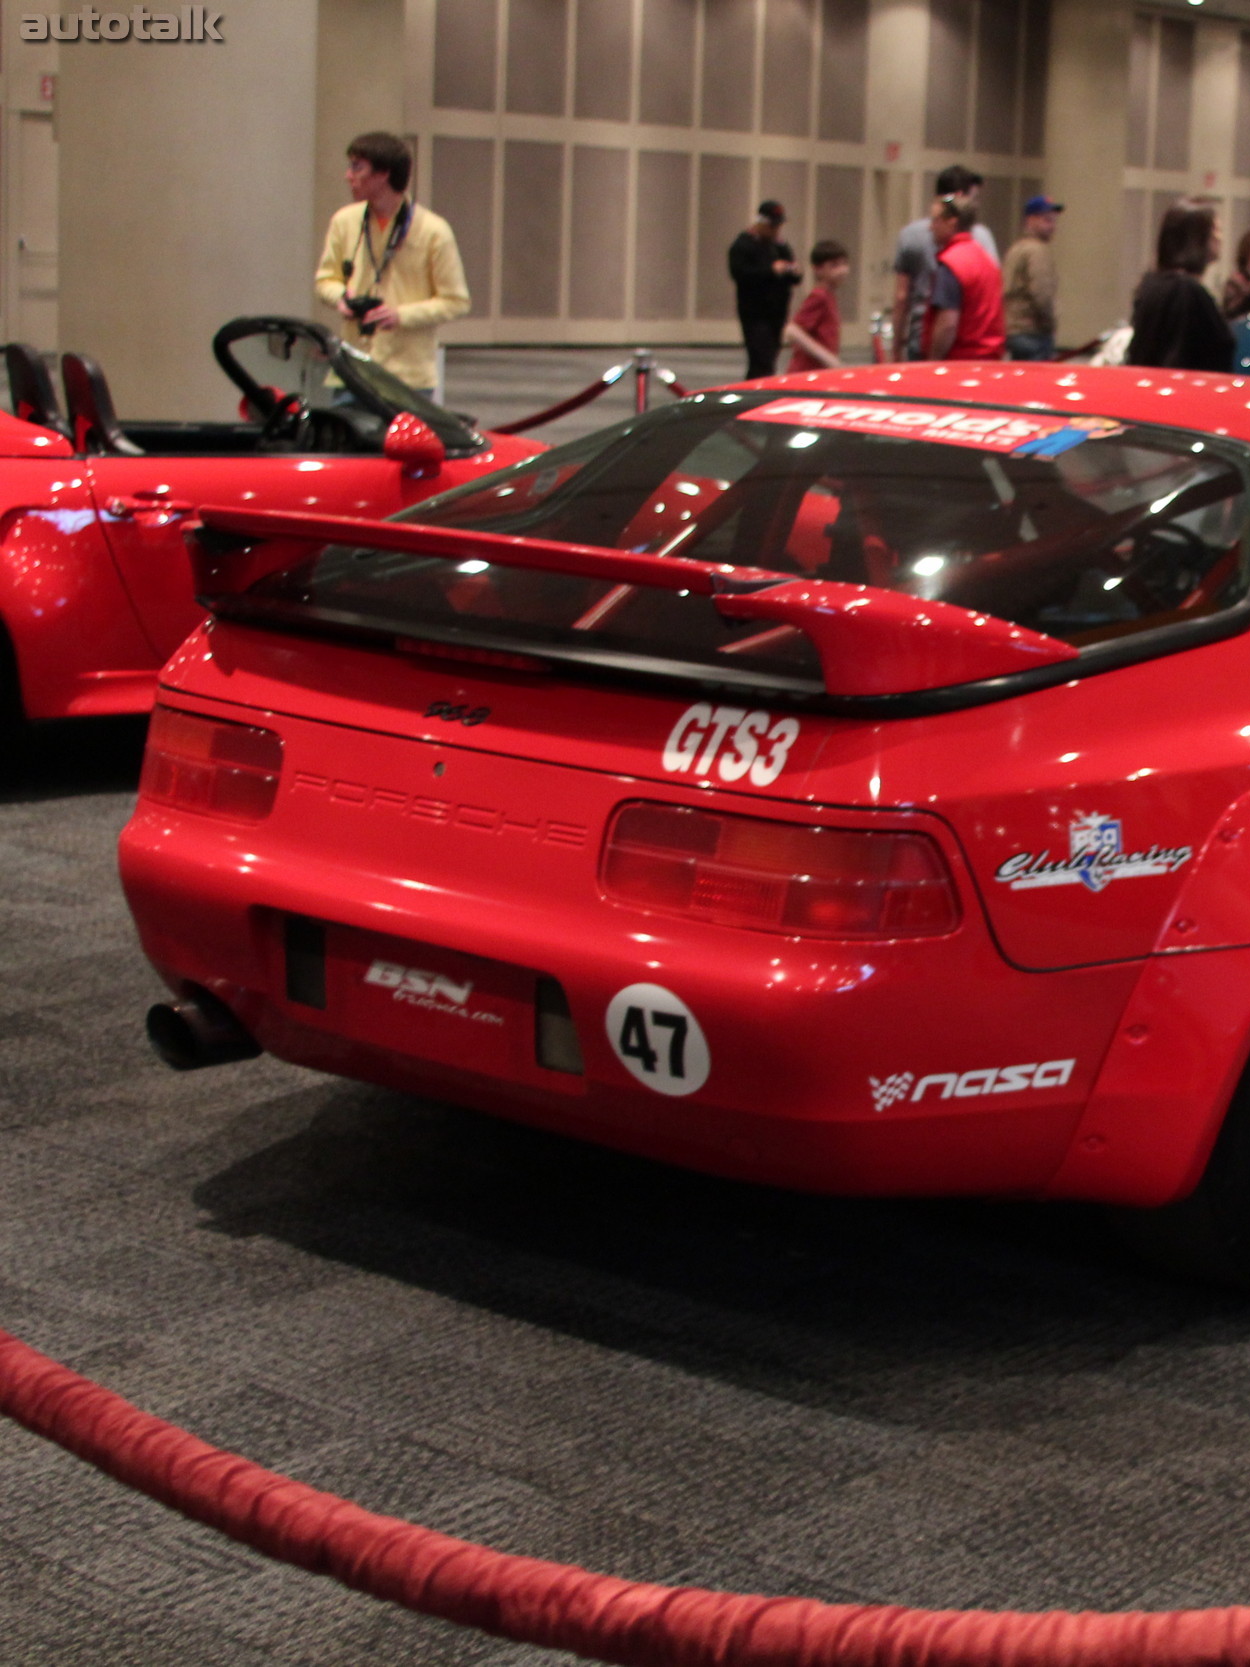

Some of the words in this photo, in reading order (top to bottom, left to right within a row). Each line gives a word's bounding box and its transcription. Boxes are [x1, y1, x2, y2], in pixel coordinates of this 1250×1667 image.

[661, 701, 801, 788] GTS3
[291, 769, 589, 850] PORSCHE
[995, 846, 1088, 882] Club
[1084, 844, 1192, 874] Racing
[618, 1005, 689, 1080] 47
[911, 1058, 1077, 1102] nasa
